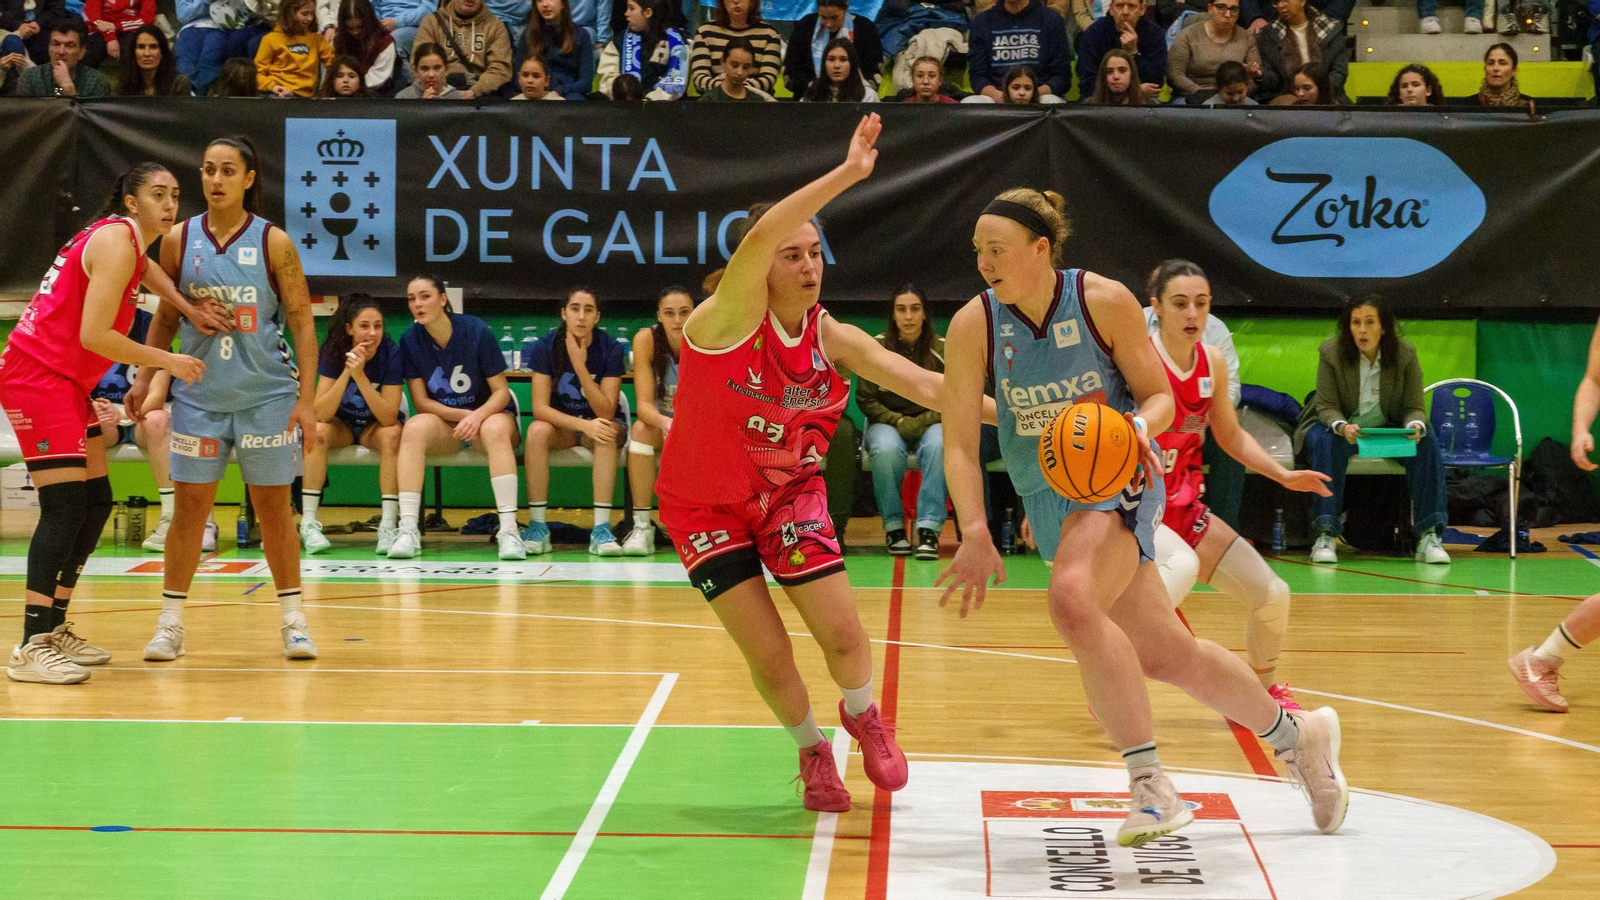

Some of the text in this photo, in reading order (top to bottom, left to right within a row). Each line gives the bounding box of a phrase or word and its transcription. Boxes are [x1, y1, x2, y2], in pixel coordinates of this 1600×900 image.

[992, 34, 1039, 46] JACK&
[992, 48, 1039, 61] JONES
[426, 135, 677, 191] XUNTA
[1265, 167, 1430, 247] Zorka
[425, 208, 836, 266] DE GALIC
[220, 335, 234, 360] 8
[726, 378, 775, 403] Extremadura
[784, 385, 813, 397] alter
[1001, 370, 1103, 408] femxa
[1021, 422, 1036, 431] DE
[1072, 413, 1088, 452] EVO
[131, 512, 142, 543] bulk
[1042, 826, 1116, 892] CONCELLO
[1131, 834, 1204, 884] DE VIGO
